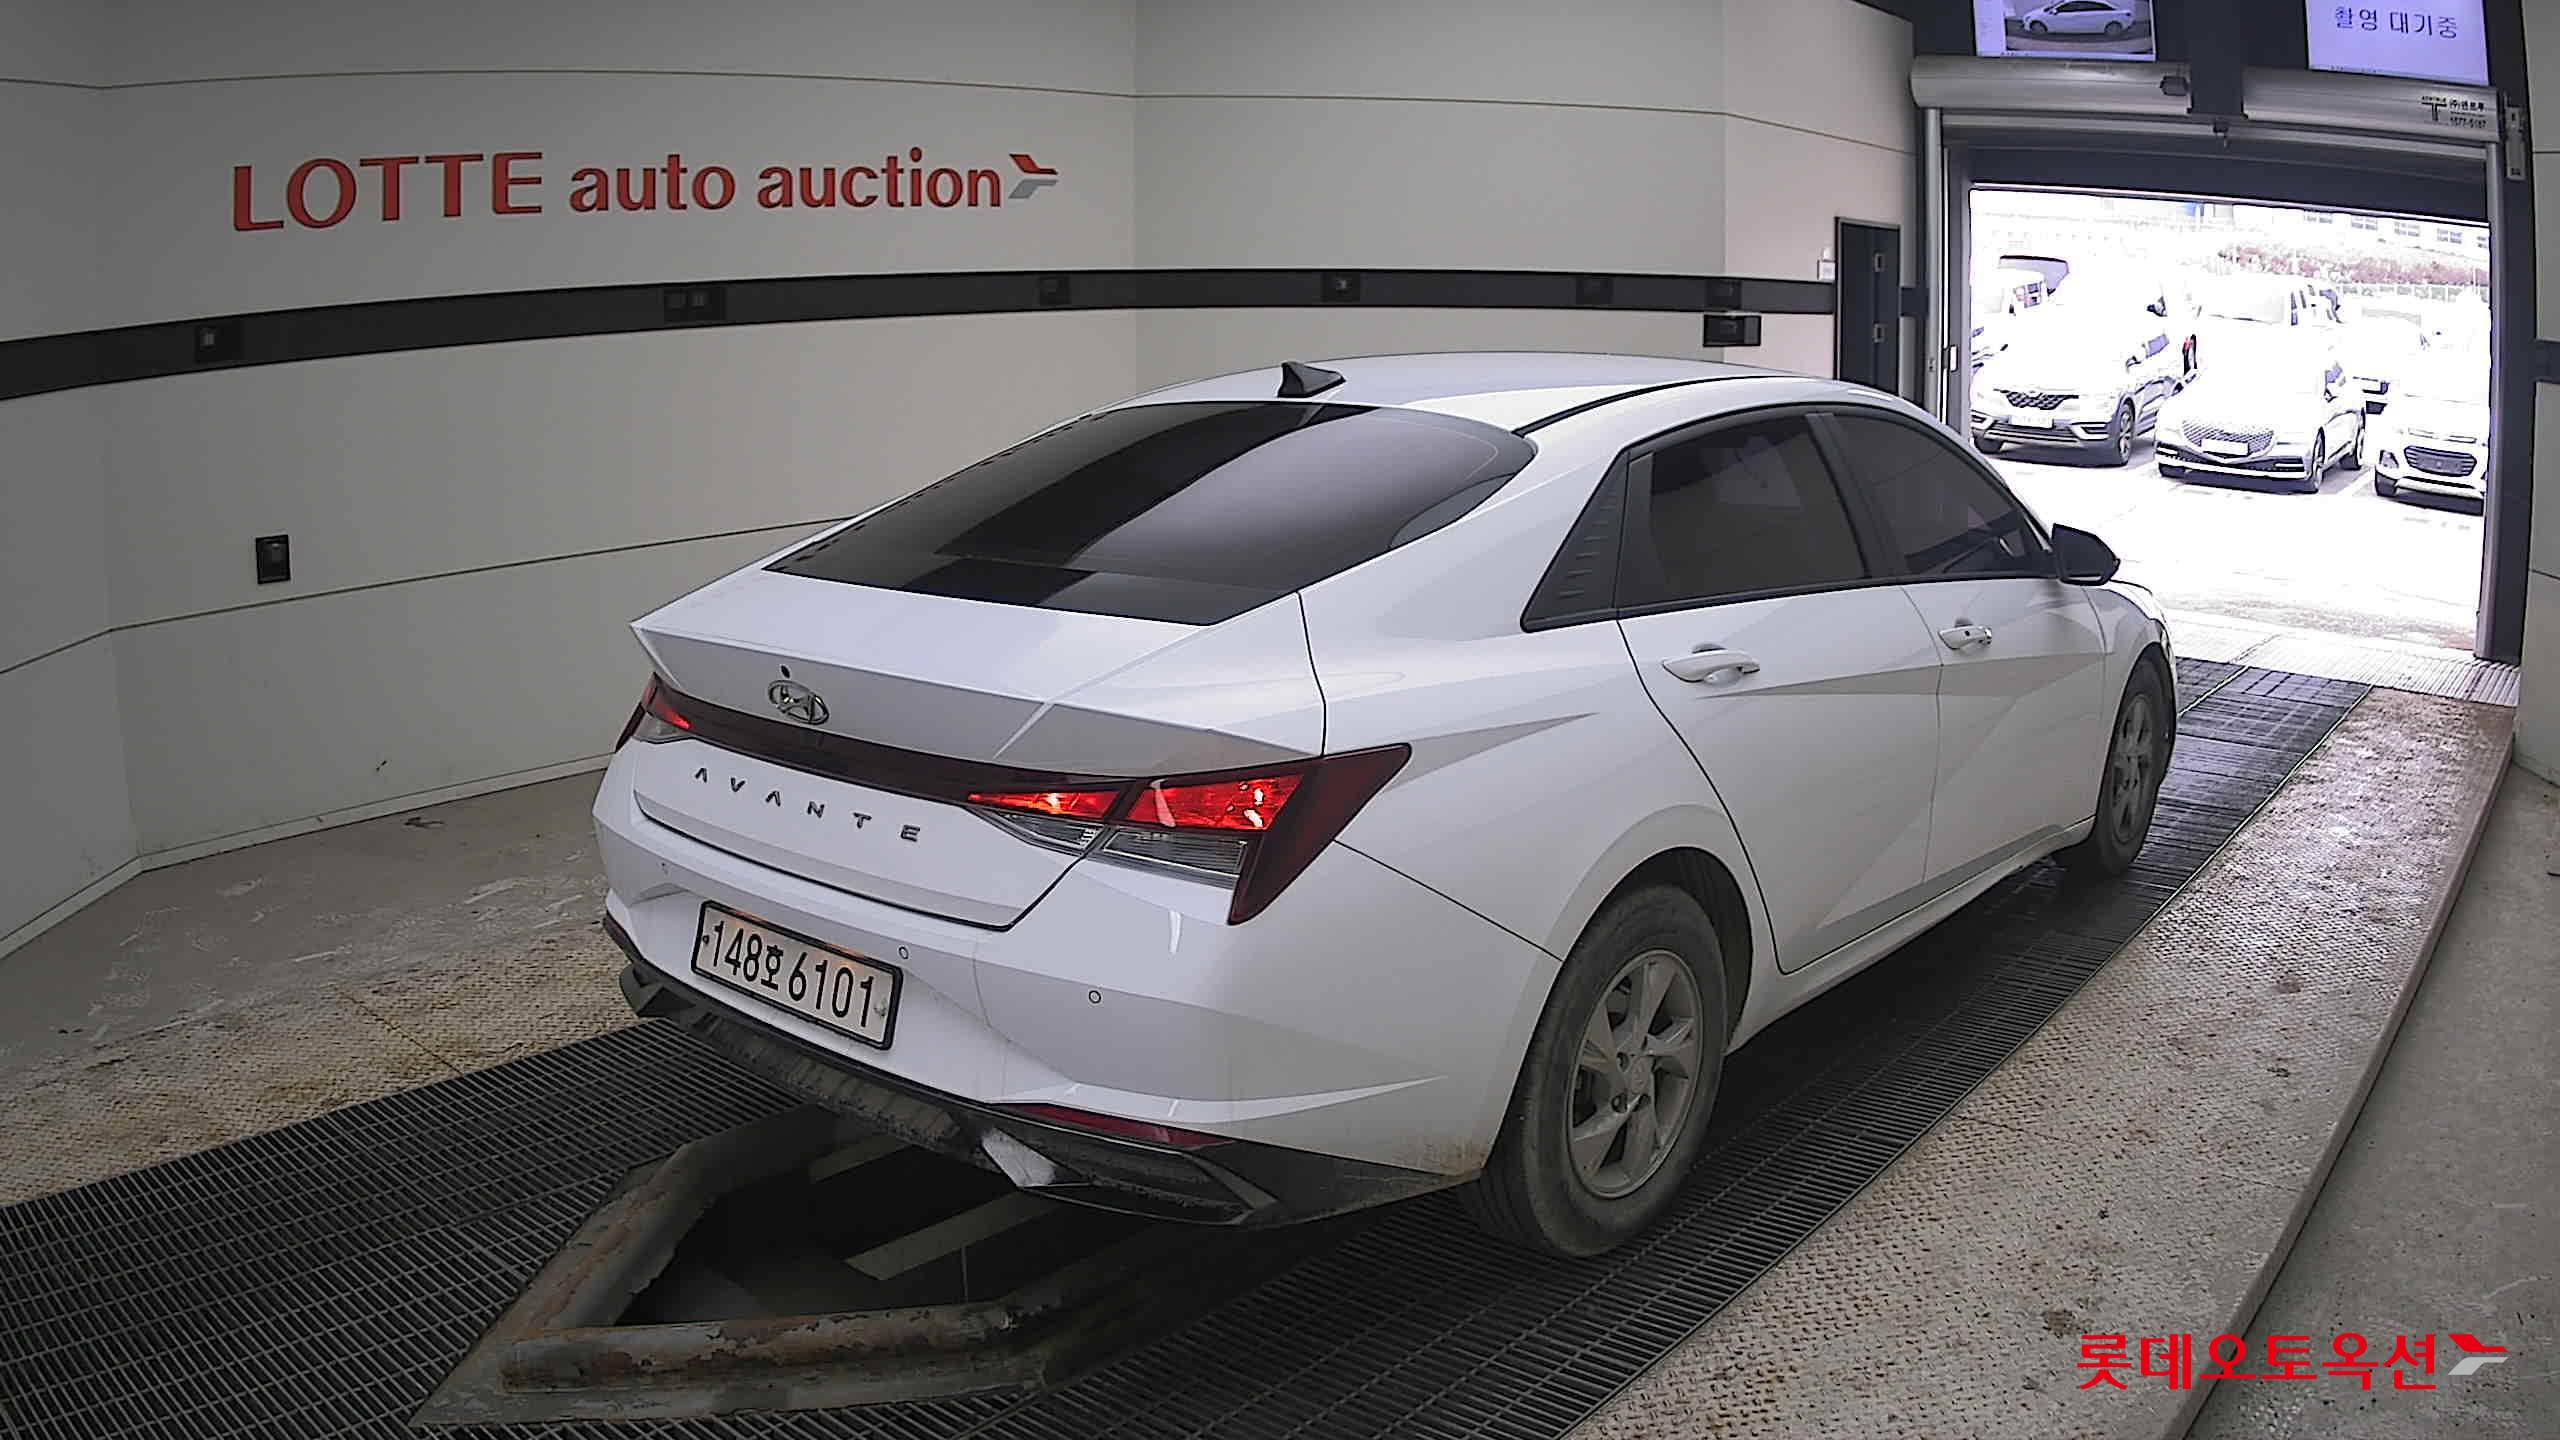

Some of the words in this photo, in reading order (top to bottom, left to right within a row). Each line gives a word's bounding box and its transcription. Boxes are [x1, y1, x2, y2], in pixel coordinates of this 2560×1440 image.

[2335, 6, 2378, 31] 촬영
[2389, 11, 2458, 39] 대기중
[235, 152, 543, 232] LOTTE
[570, 155, 737, 212] auto
[757, 147, 1002, 210] auction
[694, 766, 922, 843] AVANTE
